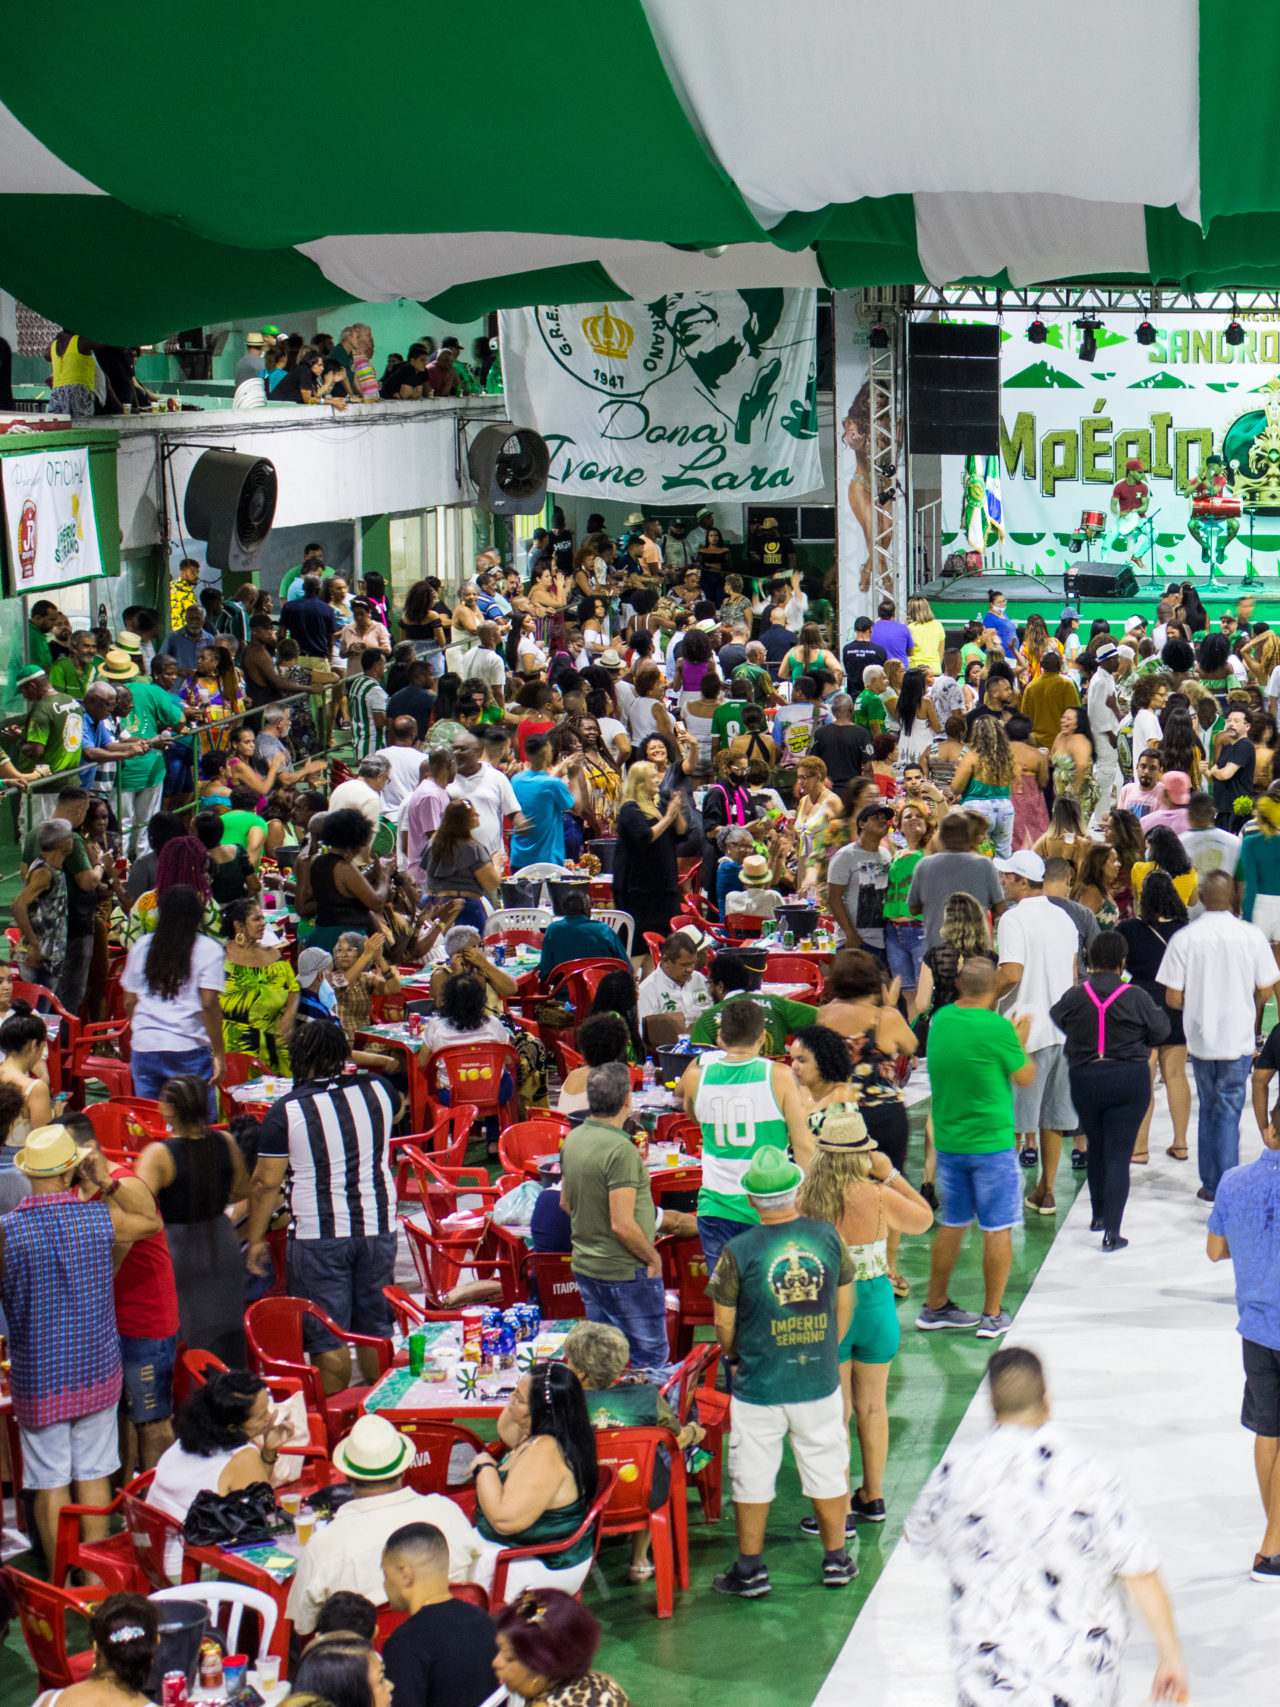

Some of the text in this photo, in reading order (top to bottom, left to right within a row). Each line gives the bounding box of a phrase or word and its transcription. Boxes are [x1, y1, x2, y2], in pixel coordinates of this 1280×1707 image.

[1148, 329, 1279, 364] SANDRO
[593, 368, 624, 389] 1947
[598, 399, 728, 446] Dona
[541, 434, 795, 491] Ivone Lara
[999, 398, 1217, 498] MPÉRIO
[46, 459, 83, 488] OFICIAL
[710, 1096, 756, 1147] 10
[552, 1281, 579, 1296] ITAIP
[776, 1330, 825, 1347] SERRANO
